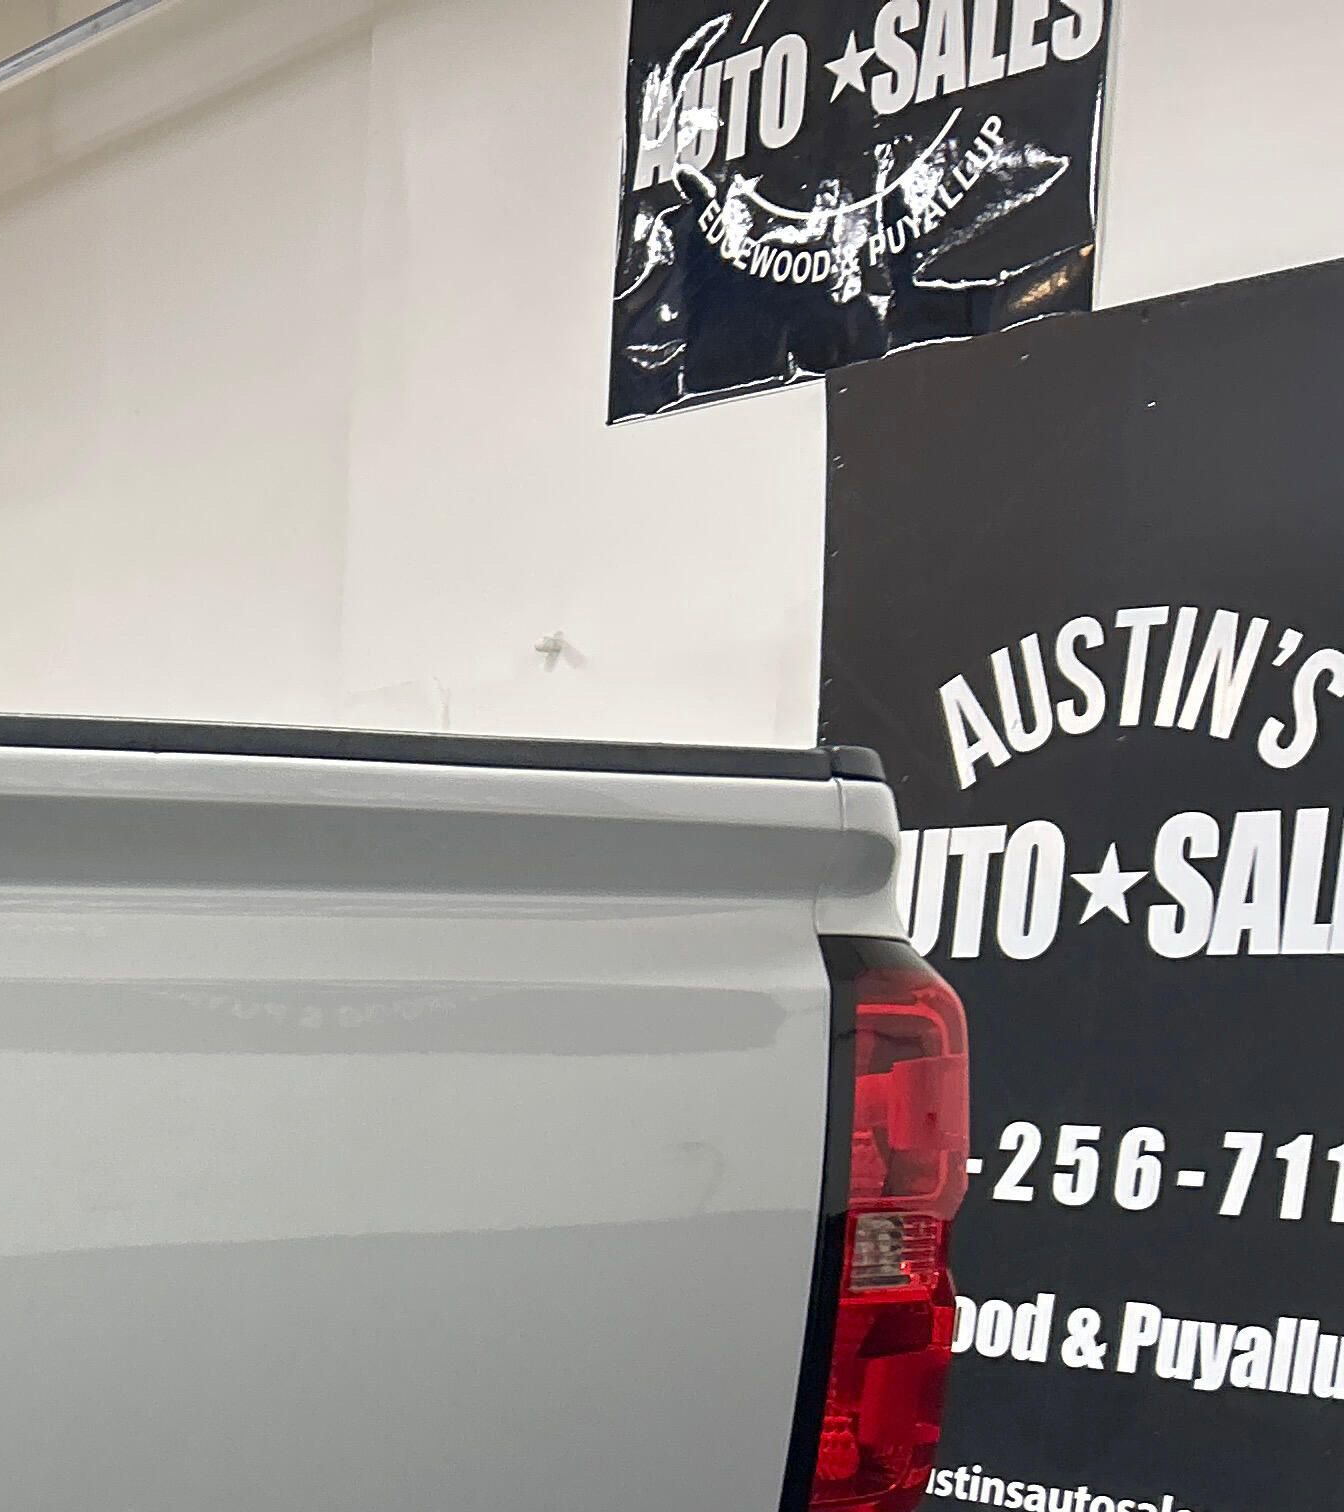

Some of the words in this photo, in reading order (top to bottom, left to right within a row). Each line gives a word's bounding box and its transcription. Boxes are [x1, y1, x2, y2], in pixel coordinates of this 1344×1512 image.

[633, 33, 809, 190] AUTO
[868, 115, 1007, 266] PUYALLUP
[938, 604, 1344, 791] AUSTIN'S
[897, 819, 1066, 960] UTO
[1147, 807, 1344, 959] SAL
[951, 1292, 1056, 1363] ood
[1061, 1307, 1108, 1370] &
[1116, 1301, 1344, 1401] Puyallu
